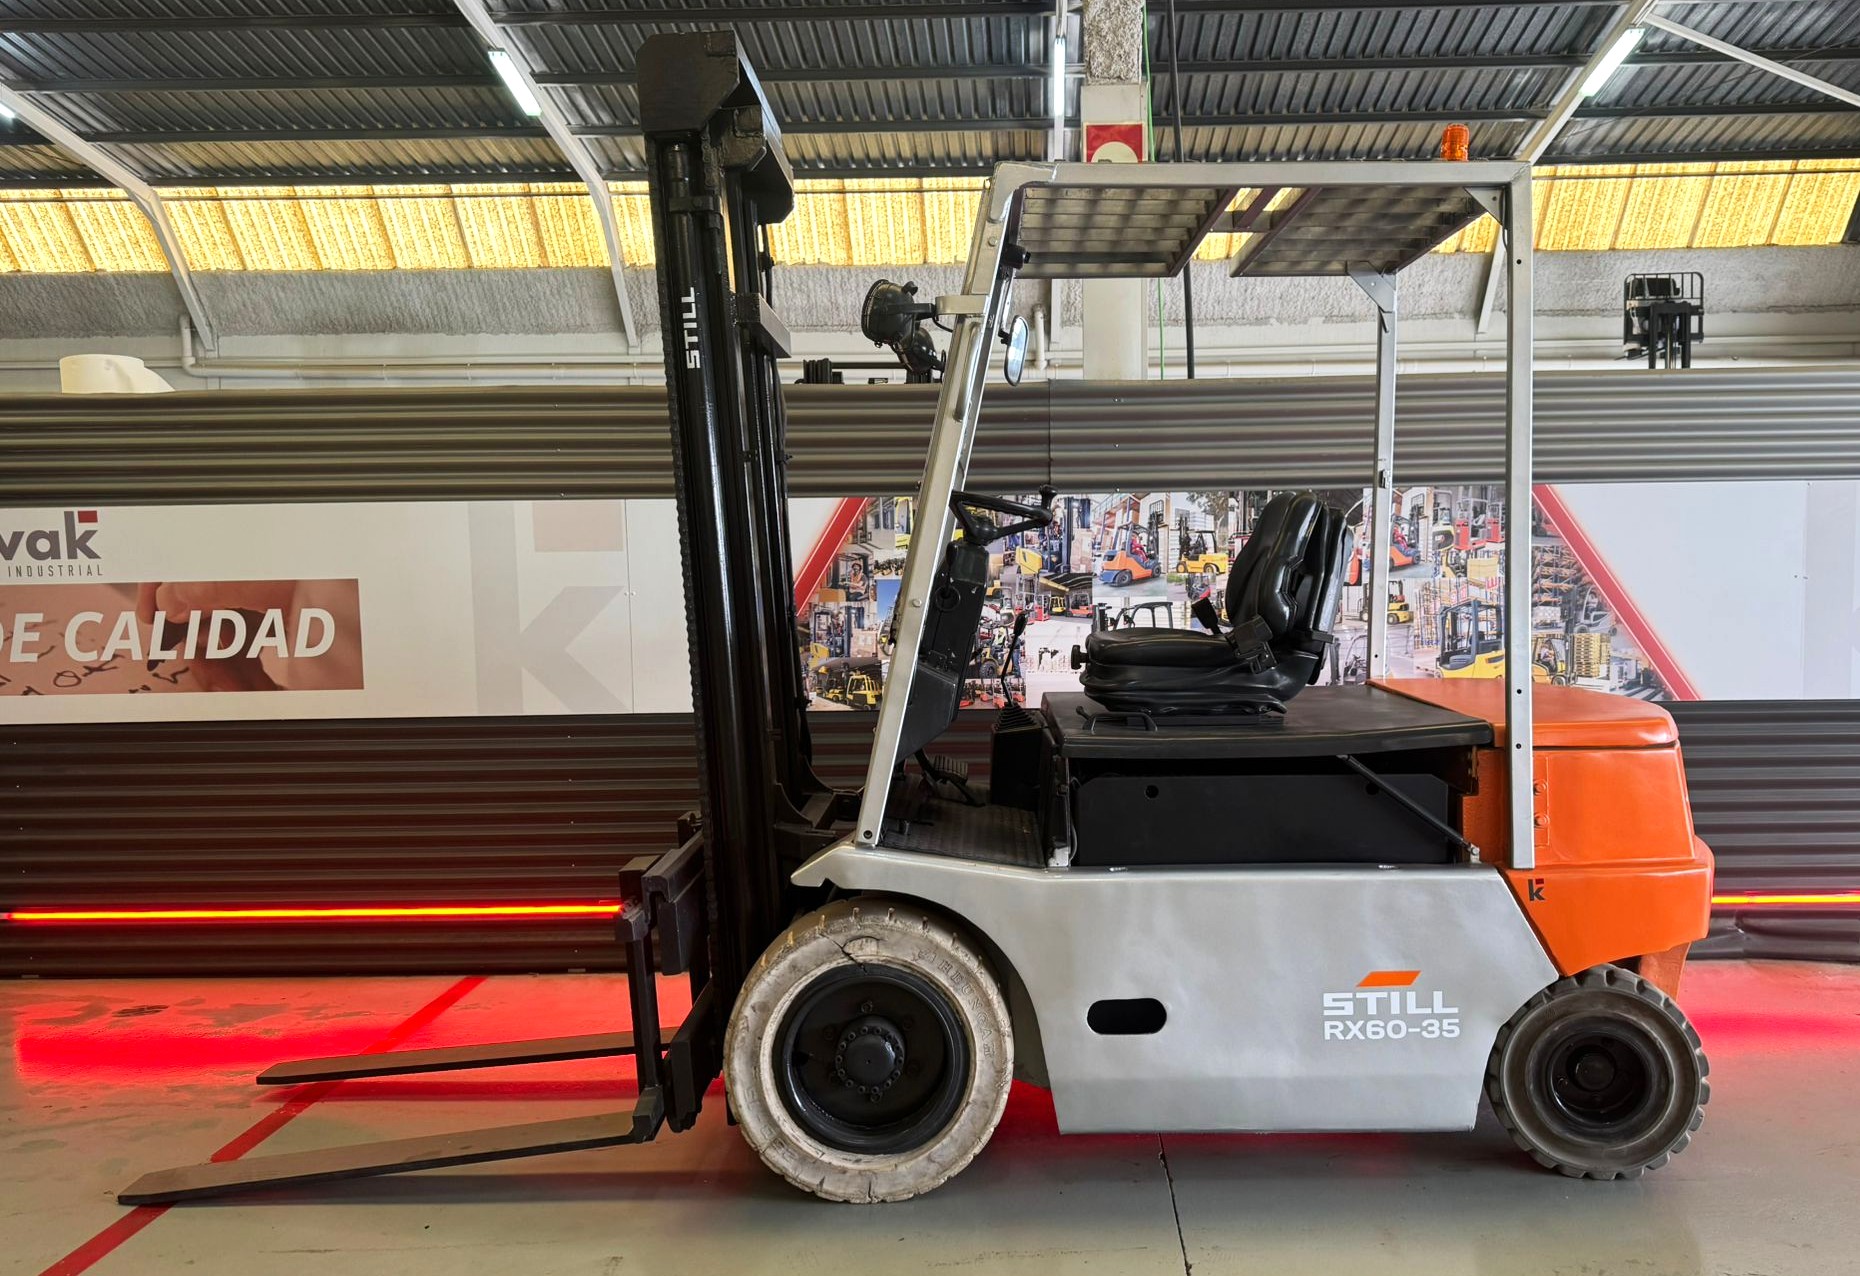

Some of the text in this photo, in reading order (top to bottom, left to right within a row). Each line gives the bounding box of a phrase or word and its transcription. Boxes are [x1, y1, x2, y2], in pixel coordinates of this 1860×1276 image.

[681, 287, 700, 369] STILL
[8, 564, 103, 577] INDUSTRIAL
[0, 608, 336, 663] E CALIDAD
[1323, 990, 1459, 1016] STILL
[1324, 1018, 1460, 1040] RX60-35
